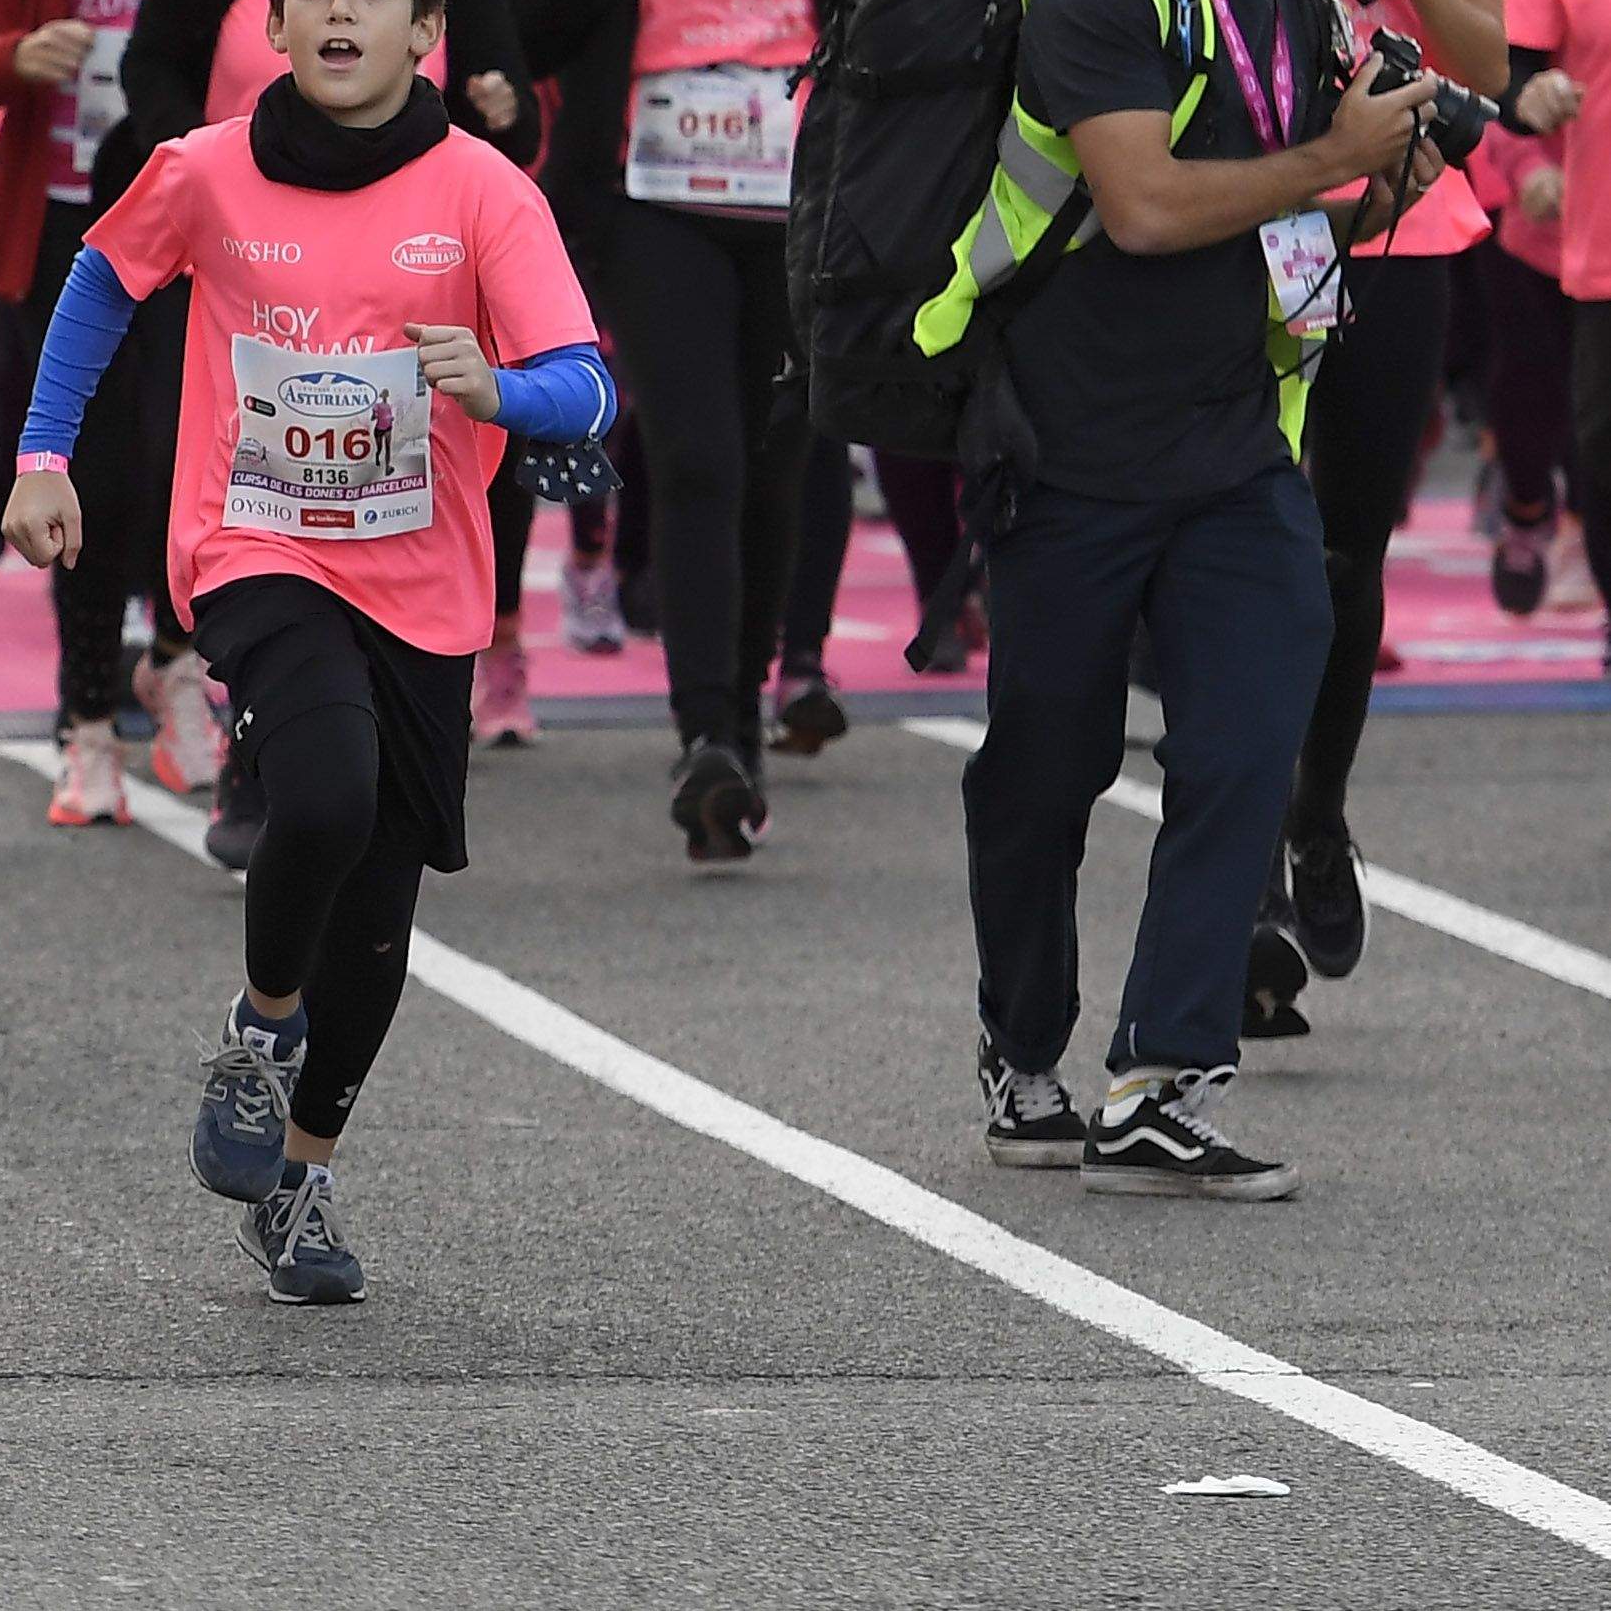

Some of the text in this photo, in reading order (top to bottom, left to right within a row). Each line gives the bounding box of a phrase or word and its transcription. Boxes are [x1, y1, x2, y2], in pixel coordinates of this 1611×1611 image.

[679, 108, 744, 140] 016
[222, 236, 303, 265] OYSHO
[252, 299, 321, 340] HOY
[284, 384, 371, 407] ASTURIANA
[284, 425, 372, 462] 016
[233, 472, 425, 499] CURSA DE LES DONES DE BARCELONA
[303, 468, 350, 486] 8136
[231, 497, 293, 523] OYSHO
[380, 505, 420, 520] ZURICH
